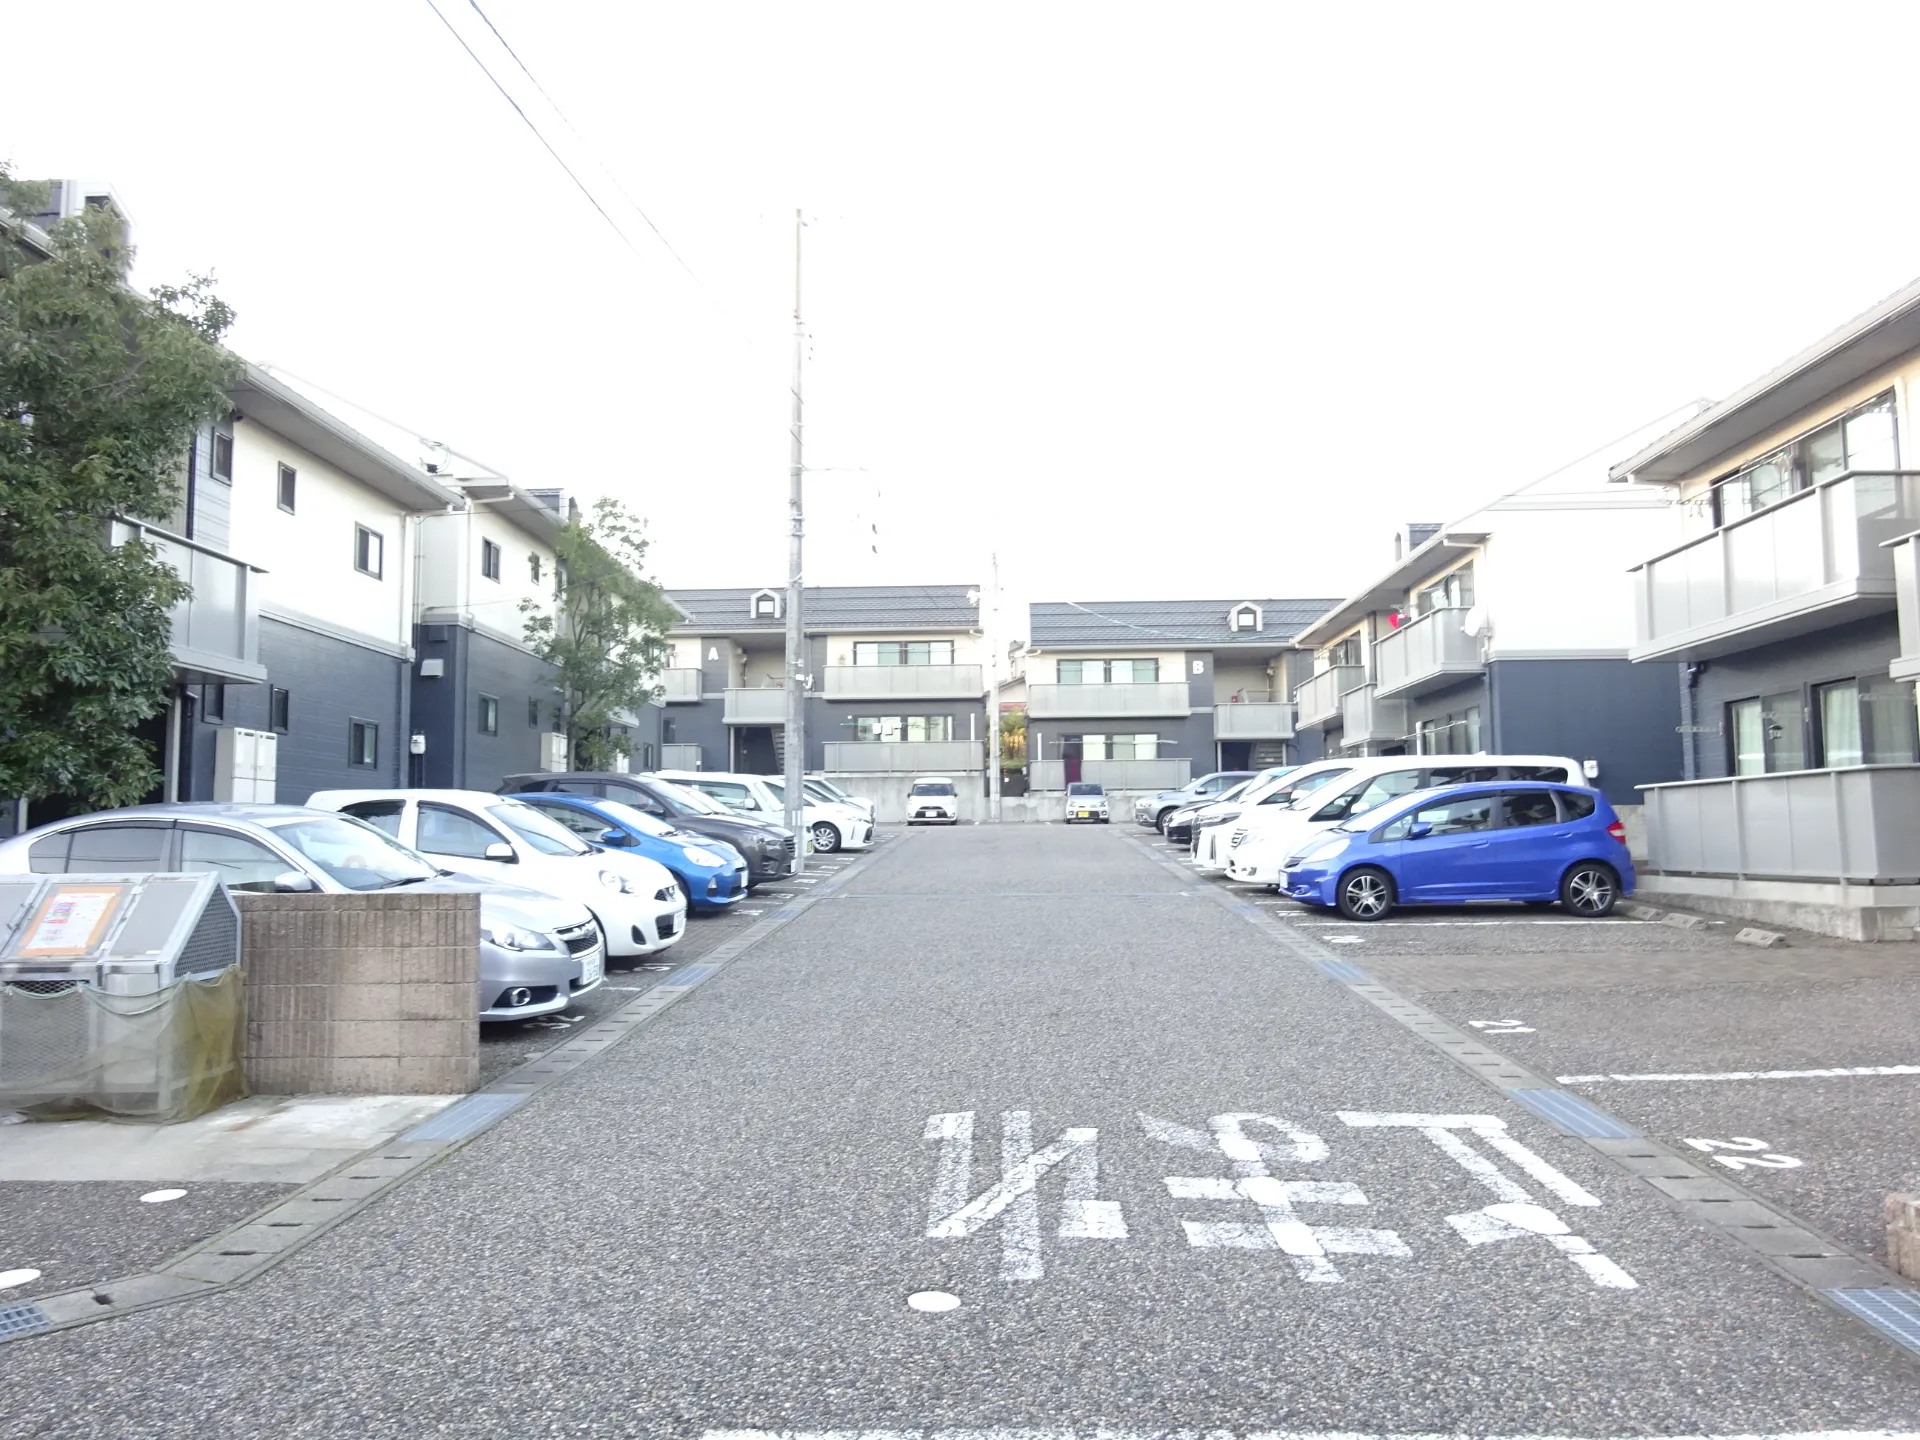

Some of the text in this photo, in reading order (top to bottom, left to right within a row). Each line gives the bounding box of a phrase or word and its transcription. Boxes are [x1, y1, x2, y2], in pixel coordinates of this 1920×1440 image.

[708, 646, 719, 661] A
[1192, 660, 1205, 675] B
[1467, 1018, 1537, 1034] 21
[1683, 1135, 1803, 1171] 22
[924, 1109, 1640, 1290] 止まれ
